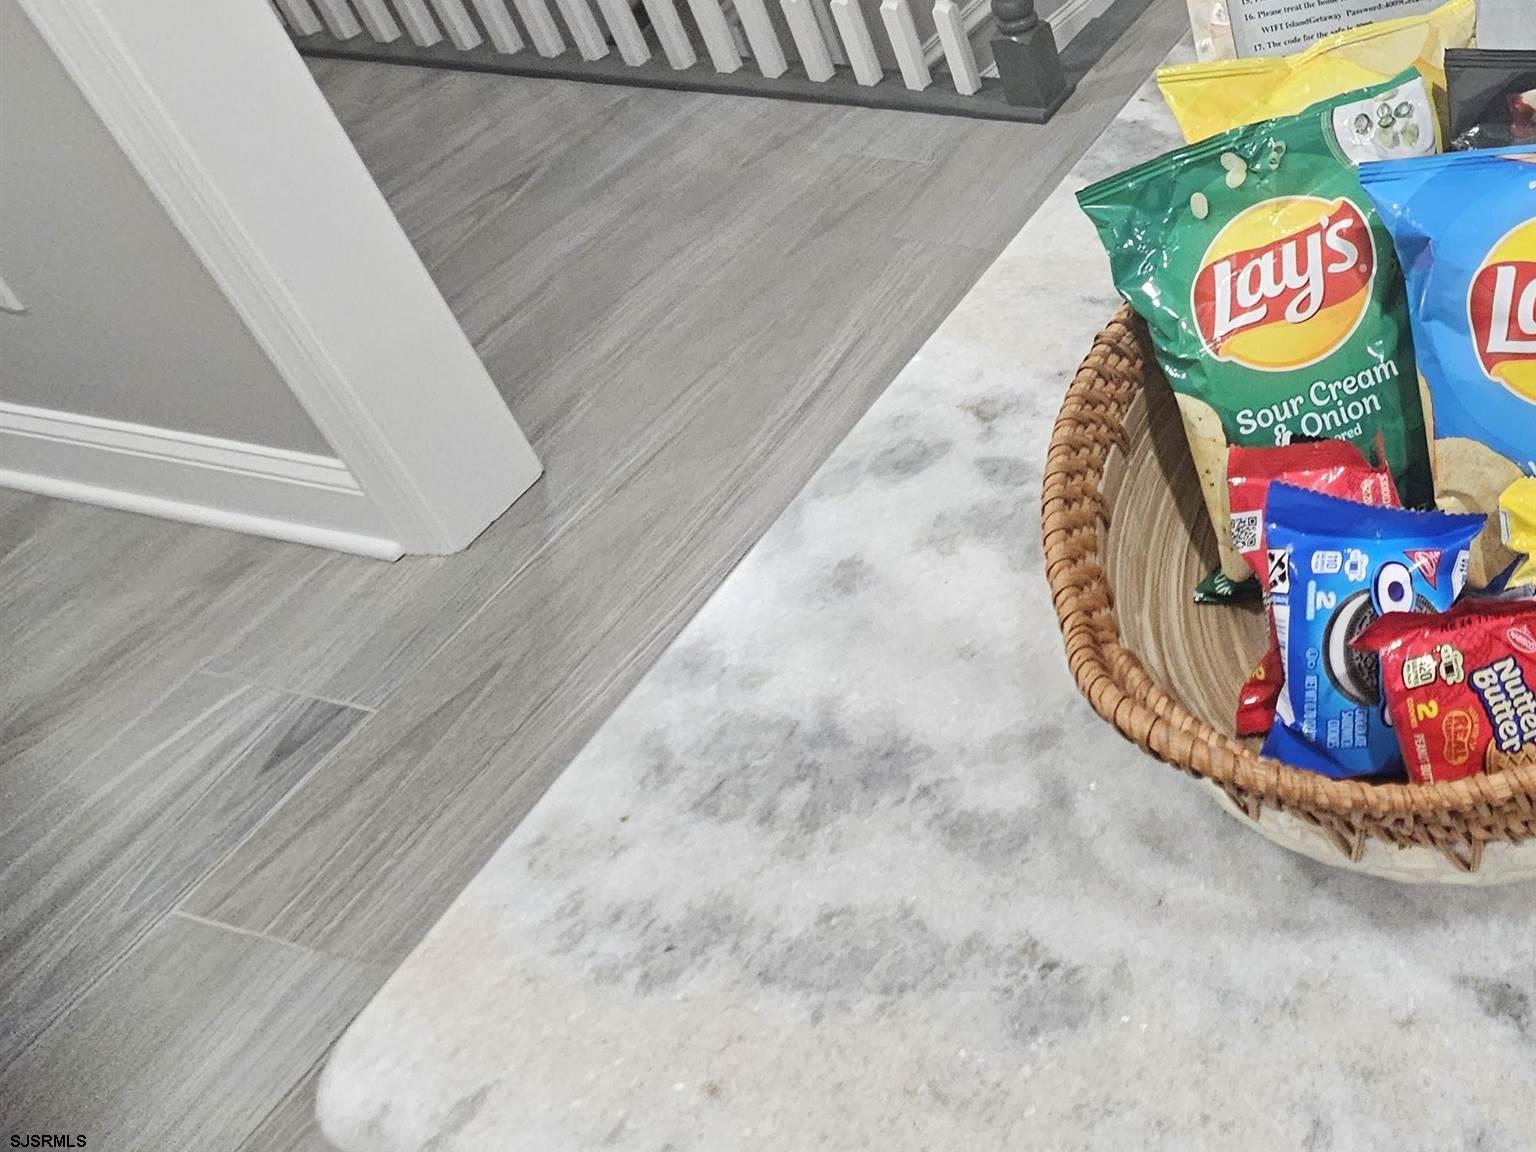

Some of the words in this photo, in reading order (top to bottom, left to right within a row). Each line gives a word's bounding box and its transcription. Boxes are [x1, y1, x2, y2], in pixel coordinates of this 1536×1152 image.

[1258, 8, 1282, 18] Please
[1284, 2, 1302, 13] treat
[1304, 1, 1316, 9] the
[1268, 38, 1282, 48] The
[1284, 34, 1301, 44] code
[1303, 32, 1314, 40] for
[1316, 28, 1328, 37] the
[1213, 215, 1359, 340] Lay's
[1236, 393, 1304, 435] Sour
[1309, 358, 1399, 406] Cream
[1300, 391, 1381, 437] Onion
[1316, 591, 1336, 610] 2
[1416, 699, 1439, 721] 2
[1472, 667, 1521, 752] Butter
